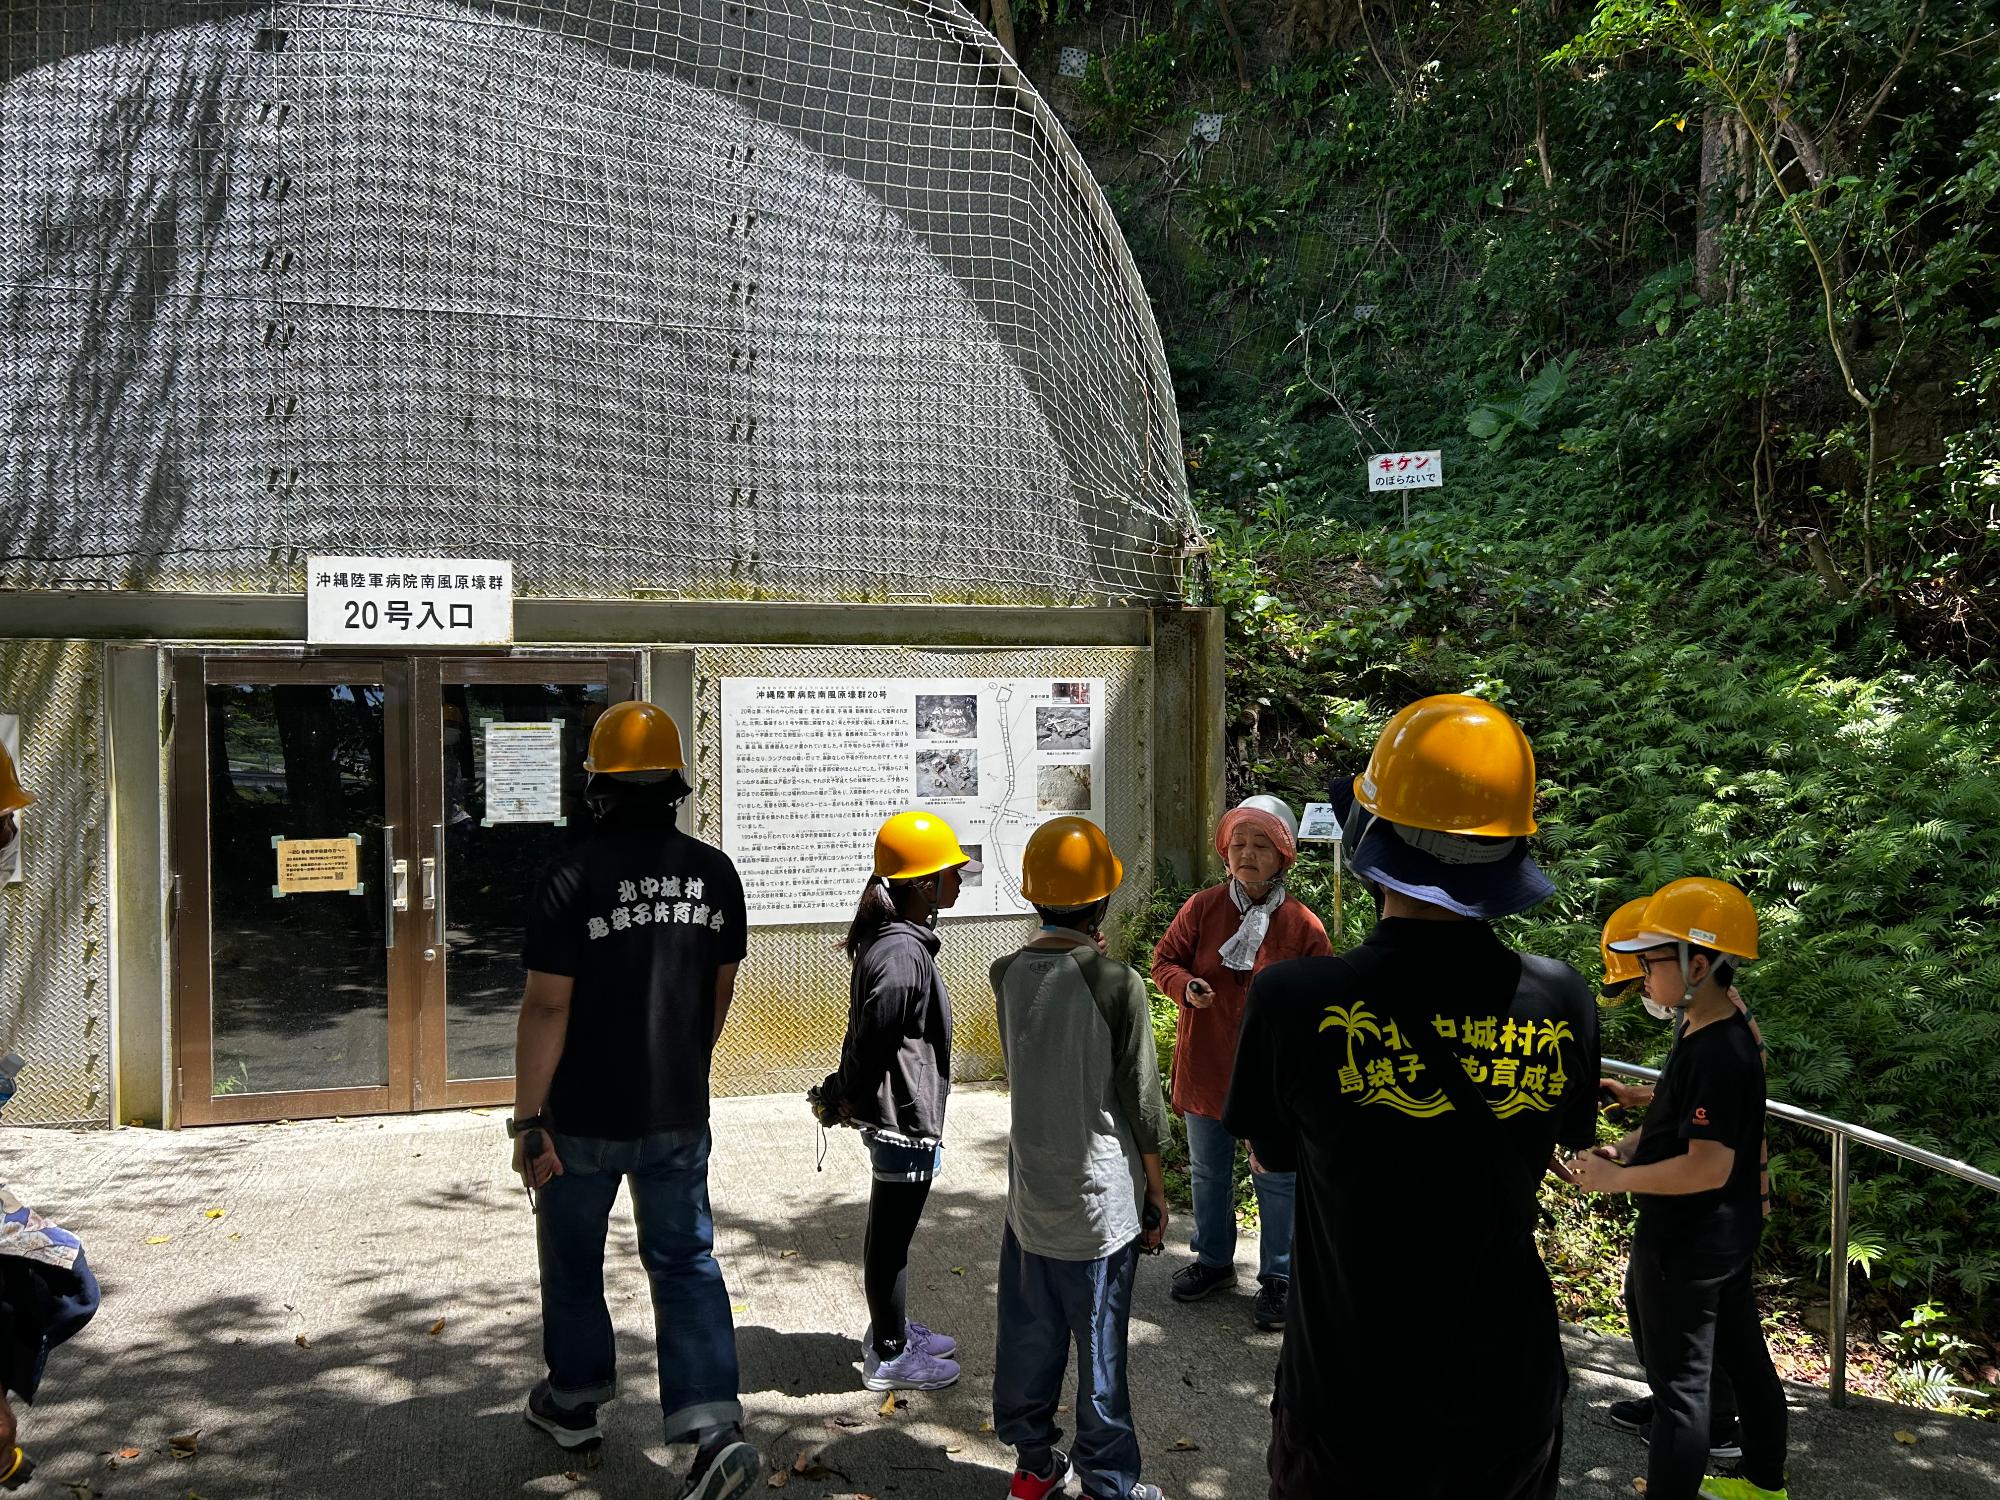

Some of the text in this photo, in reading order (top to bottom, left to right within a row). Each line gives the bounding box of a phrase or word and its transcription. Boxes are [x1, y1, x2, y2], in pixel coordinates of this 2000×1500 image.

[1379, 455, 1430, 472] キケン
[1375, 473, 1436, 486] のぼらないで
[316, 572, 504, 591] 沖縄陸軍病院南風原壕群
[344, 600, 473, 630] 20号入口
[756, 690, 887, 700] 沖縄陸軍病院南風原壕群20号
[617, 876, 704, 903] 北中城村
[1337, 1053, 1568, 1097] 島袋子も育成会
